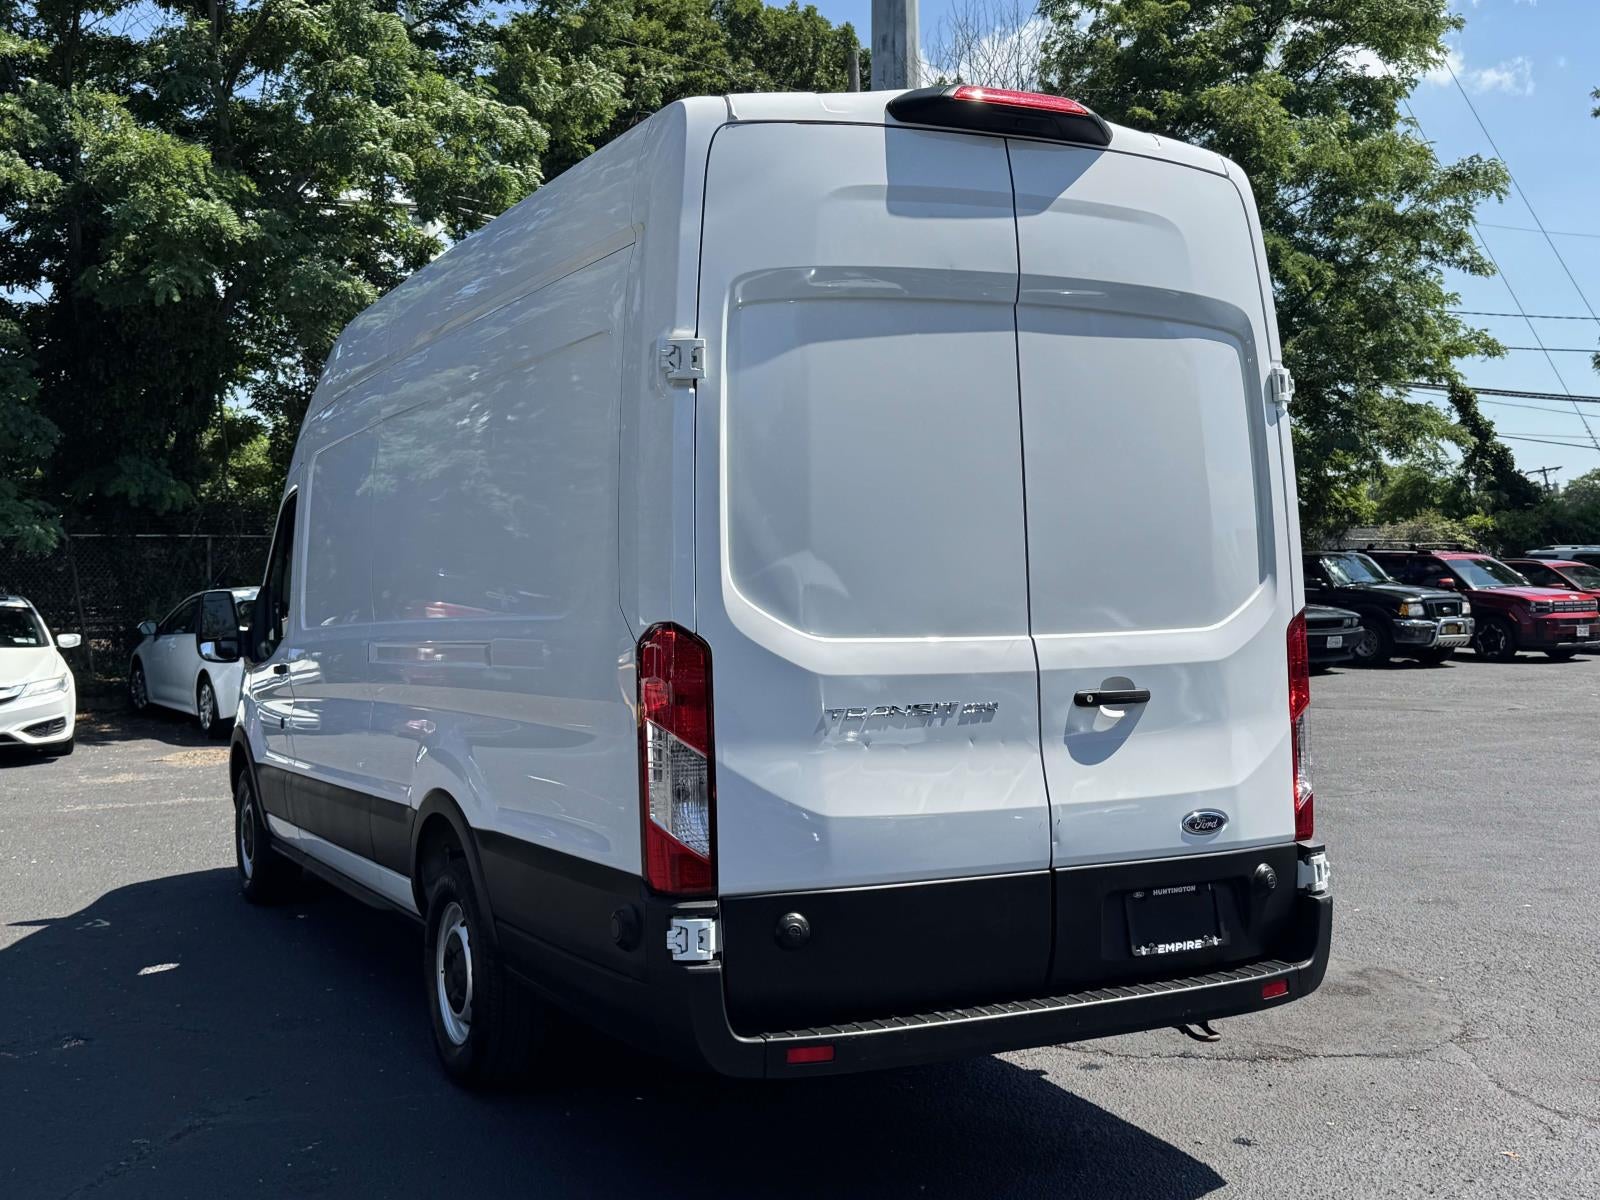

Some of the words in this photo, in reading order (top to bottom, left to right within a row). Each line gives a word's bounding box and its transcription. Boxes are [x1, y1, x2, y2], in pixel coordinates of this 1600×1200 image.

[824, 700, 960, 721] TRANSIT
[1194, 816, 1217, 830] Ford
[1152, 885, 1196, 896] HUNTINGTON
[1157, 939, 1202, 954] EMPIRE
